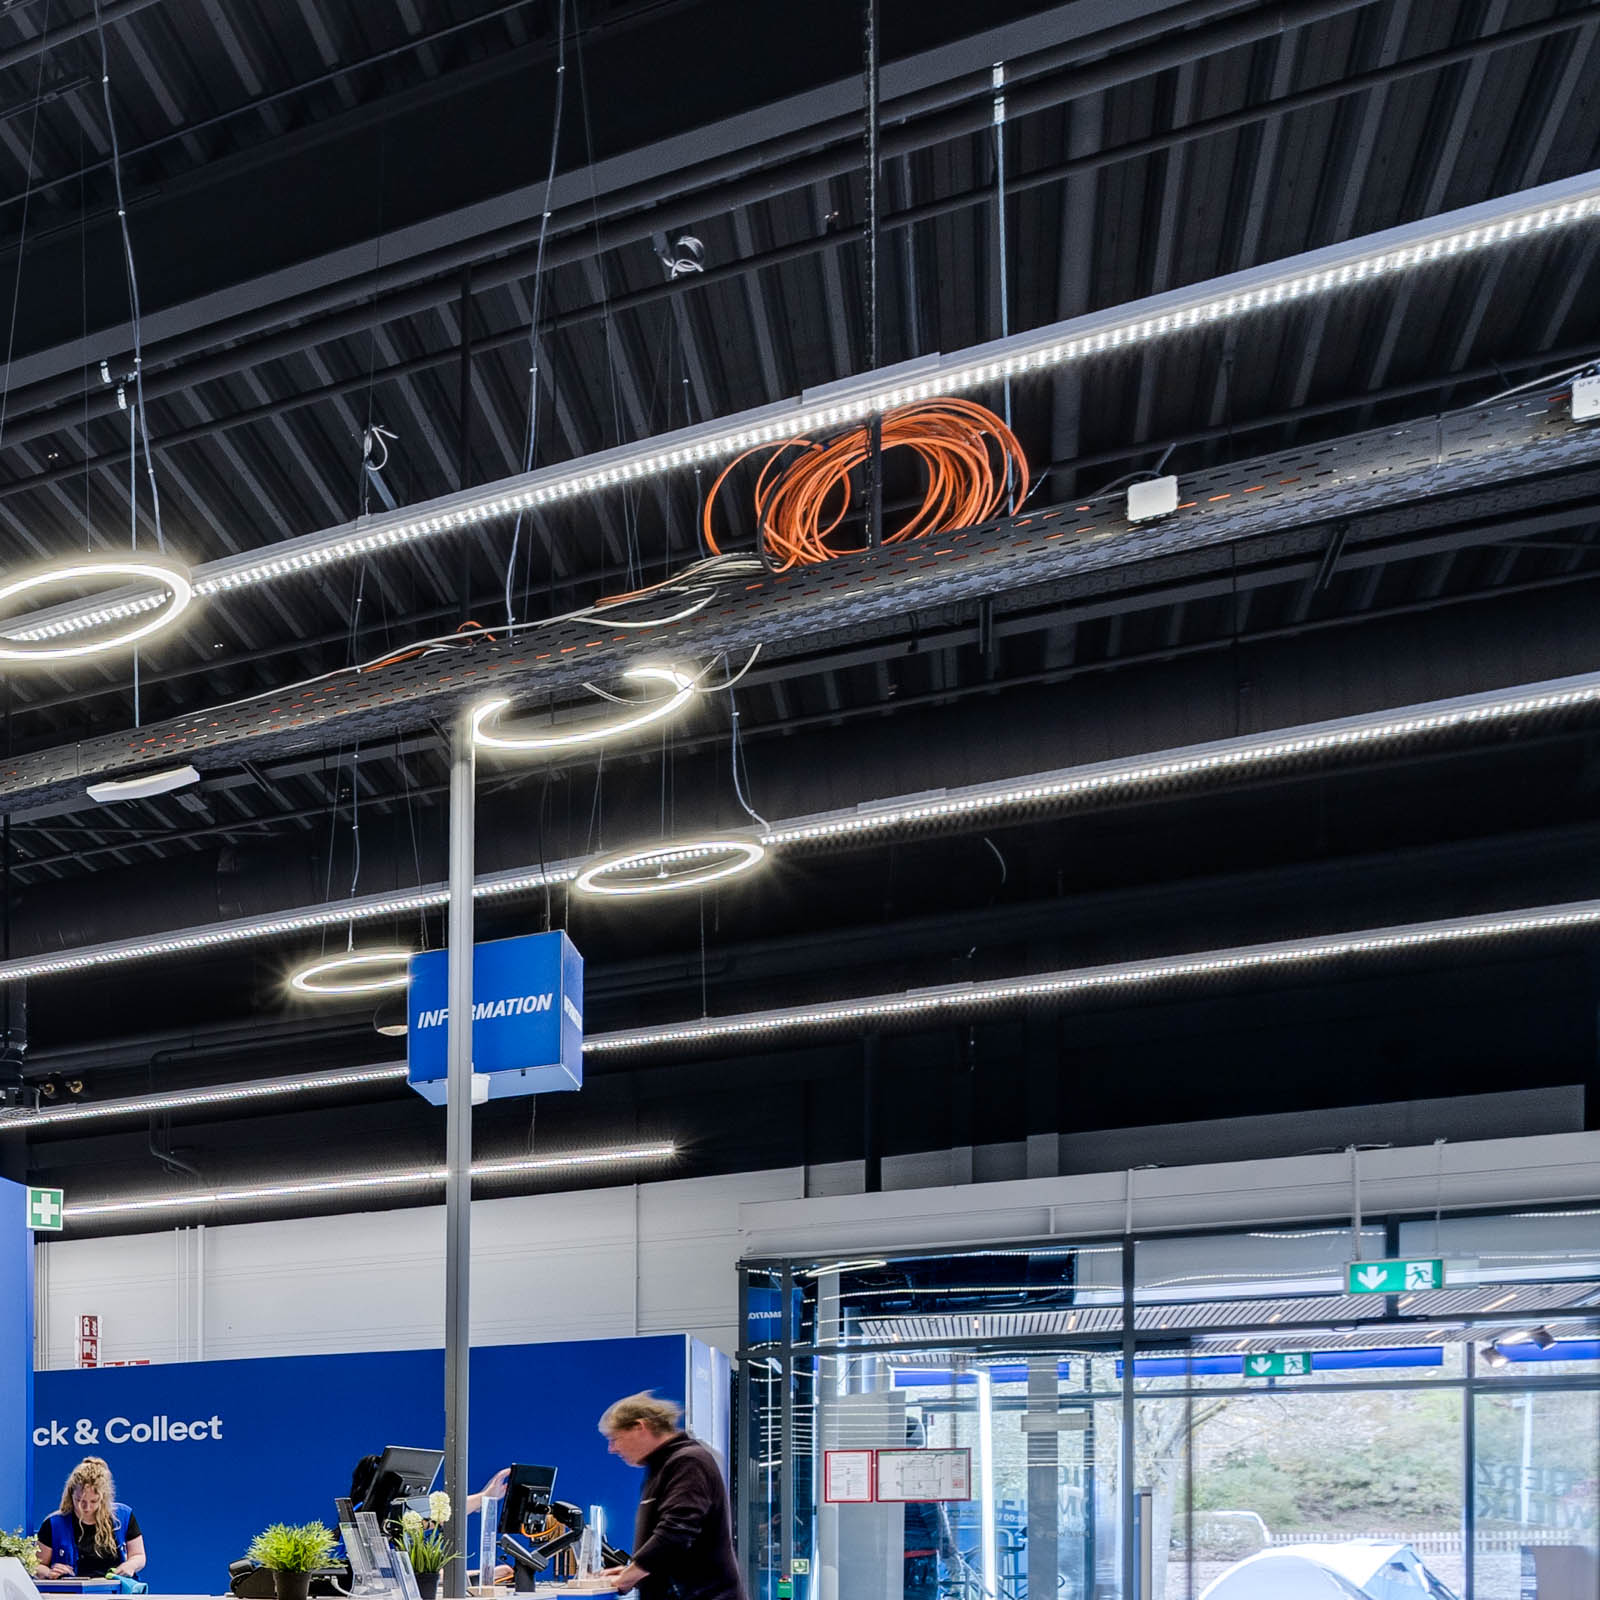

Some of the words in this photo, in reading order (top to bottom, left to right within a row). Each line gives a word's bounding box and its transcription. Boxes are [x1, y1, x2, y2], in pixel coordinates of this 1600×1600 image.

[417, 993, 553, 1029] INFMATION
[74, 1418, 99, 1445] &
[104, 1415, 223, 1444] Collect
